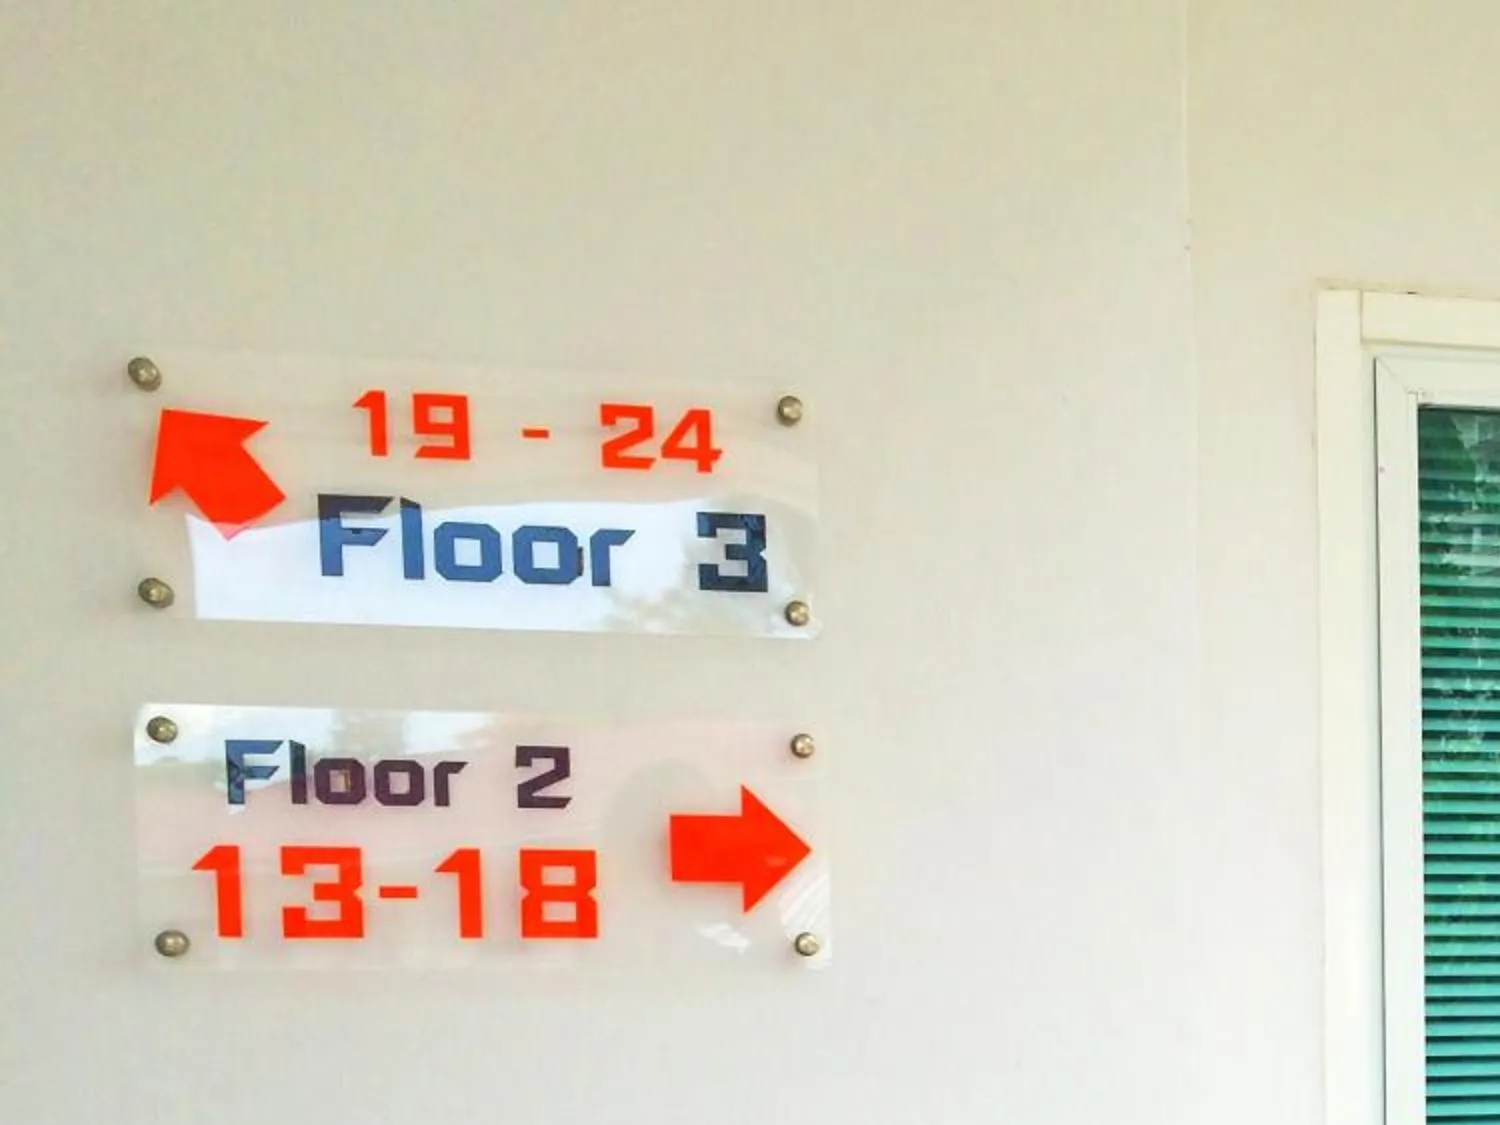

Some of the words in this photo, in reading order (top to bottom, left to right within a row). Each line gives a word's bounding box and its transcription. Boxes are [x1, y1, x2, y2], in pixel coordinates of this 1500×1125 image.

[353, 390, 471, 461] 19
[599, 403, 723, 474] 24
[317, 494, 636, 587] Floor
[697, 511, 769, 593] 3
[224, 739, 469, 807] Floor
[515, 745, 572, 809] 2
